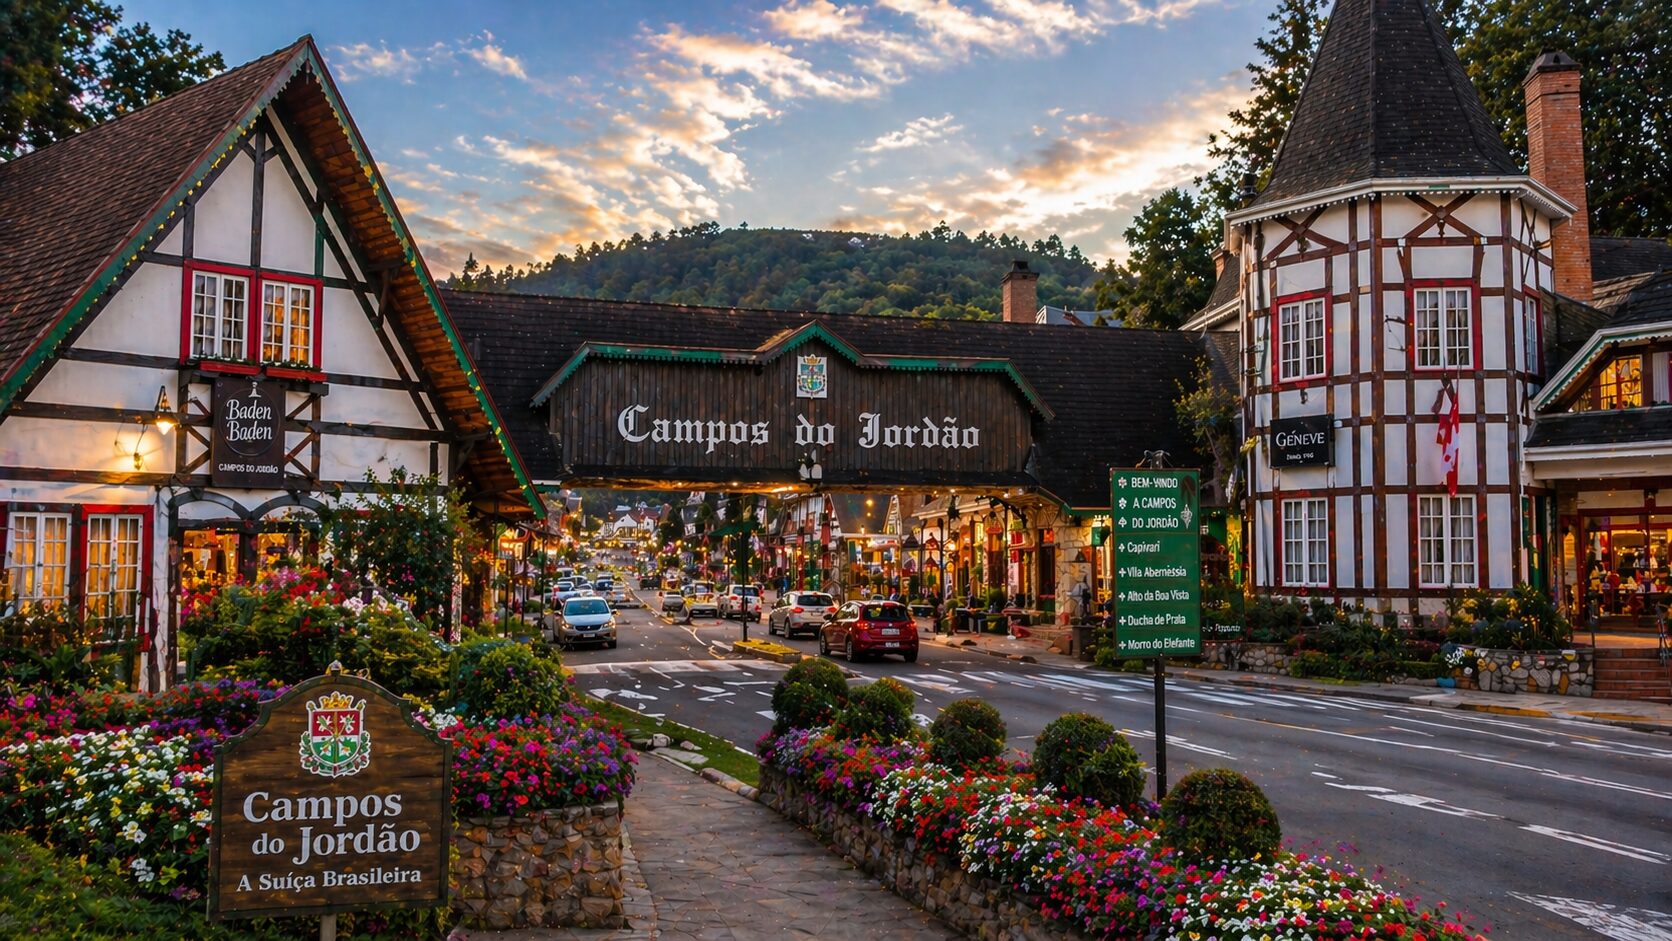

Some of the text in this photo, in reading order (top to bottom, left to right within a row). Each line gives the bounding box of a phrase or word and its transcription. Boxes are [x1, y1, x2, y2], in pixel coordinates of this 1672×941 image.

[226, 399, 272, 420] Baden
[226, 420, 272, 441] Baden
[617, 404, 980, 454] Campos do Jordão
[1133, 497, 1177, 509] A CAMPOS
[1132, 514, 1179, 528] DO JORDÃO
[1144, 590, 1154, 601] da
[1155, 590, 1170, 601] Boa
[1170, 589, 1190, 600] Vista
[1127, 614, 1154, 626] Ducha
[1154, 613, 1165, 625] de
[1127, 639, 1152, 650] Morro
[1152, 638, 1163, 649] do
[243, 791, 403, 827] Campos
[251, 823, 421, 865] do Jordão
[236, 867, 422, 893] A Suíça Brasileira
